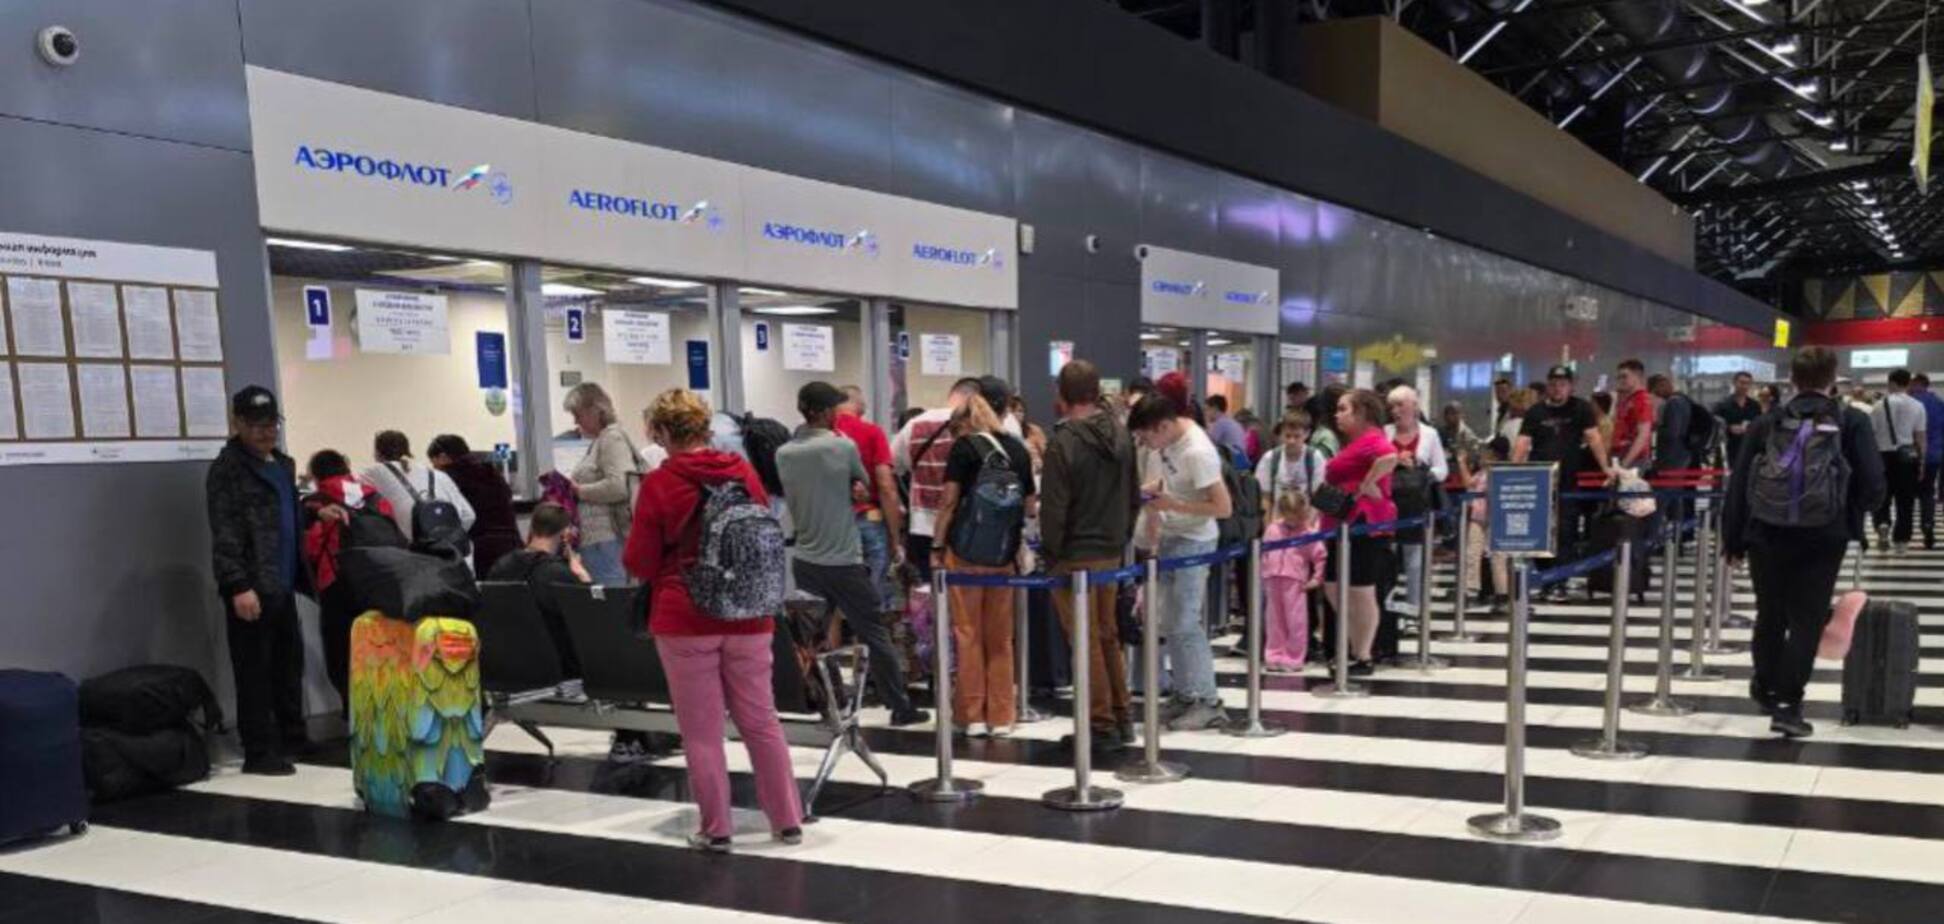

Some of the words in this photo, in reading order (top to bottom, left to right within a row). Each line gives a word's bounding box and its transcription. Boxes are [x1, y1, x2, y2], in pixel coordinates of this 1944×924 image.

[295, 145, 451, 187] АЭРОФЛОТ
[569, 190, 679, 221] AEROFLOT
[763, 223, 845, 248] АЭРОФЛОТ
[913, 244, 976, 265] AEROFLOT
[312, 299, 322, 317] 1
[570, 317, 580, 332] 2
